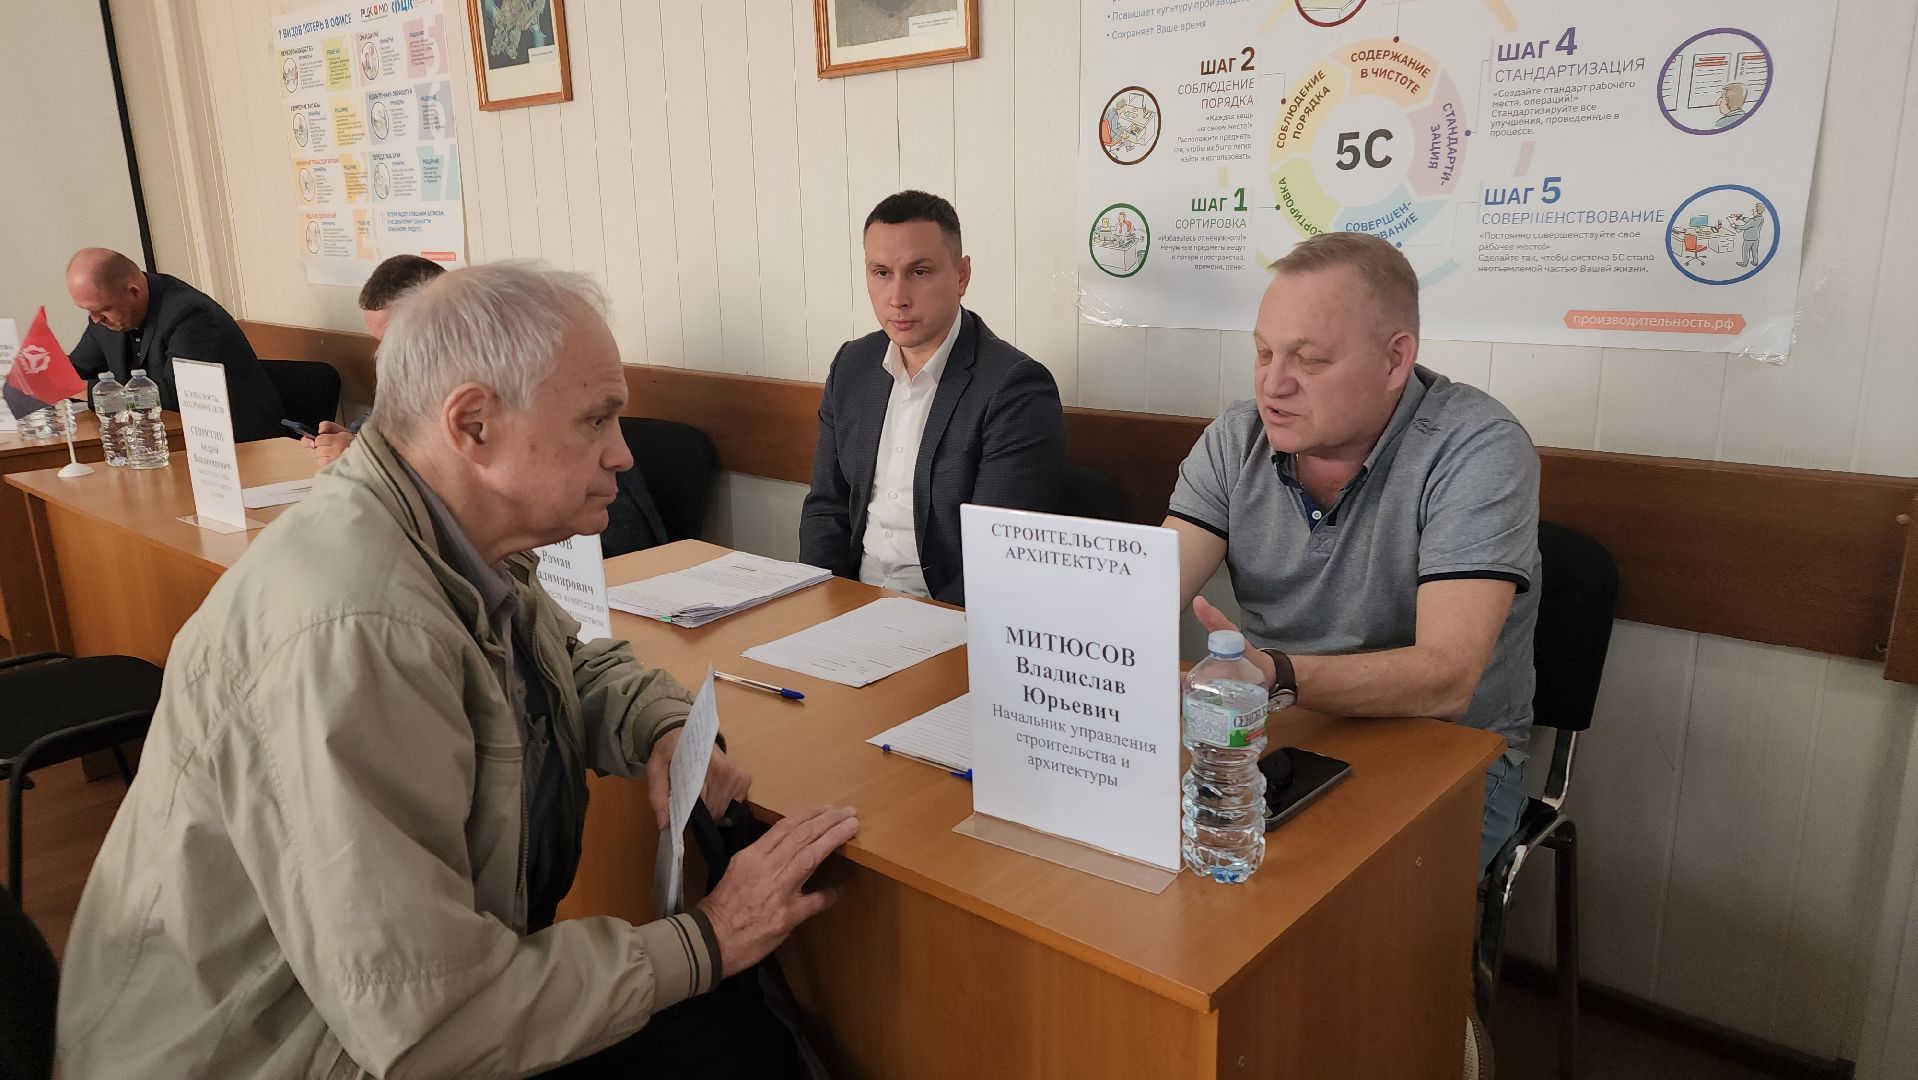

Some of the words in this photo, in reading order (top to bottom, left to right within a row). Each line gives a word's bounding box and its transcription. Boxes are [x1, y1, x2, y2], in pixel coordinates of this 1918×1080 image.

[1112, 7, 1154, 21] Повышает
[1156, 2, 1193, 16] культуру
[282, 25, 303, 39] ВИДОВ
[302, 20, 324, 34] ПОТЕРЬ
[325, 19, 330, 29] В
[329, 13, 352, 28] ОФИСЕ
[1111, 27, 1154, 40] Сохраняет
[1156, 23, 1179, 34] Ваше
[1180, 20, 1207, 32] время
[1497, 39, 1550, 61] ШАГ
[1555, 26, 1578, 55] 4
[1200, 57, 1237, 75] ШАГ
[1241, 46, 1255, 71] 2
[1350, 49, 1432, 79] СОДЕРЖАНИЕ
[1495, 57, 1646, 83] СТАНДАРТИЗАЦИЯ
[1177, 78, 1256, 95] СОБЛЮДЕНИЕ
[1360, 68, 1369, 79] В
[1371, 67, 1421, 95] ЧИСТОТЕ
[1493, 87, 1542, 98] «Создайте
[1543, 84, 1588, 96] стандарт
[1589, 80, 1636, 93] рабочего
[1201, 95, 1254, 110] ПОРЯДКА
[1276, 69, 1326, 149] СОБЛЮДЕНИЕ
[1292, 85, 1331, 140] ПОРЯДКА
[1491, 104, 1579, 118] Стандартизируйте
[1580, 104, 1597, 112] все
[1524, 95, 1579, 107] операций!»
[1490, 118, 1544, 130] улучшения,
[1545, 113, 1612, 125] проведенные
[1335, 128, 1394, 171] 5С
[1427, 124, 1441, 170] ЗАЦИЯ
[1440, 102, 1459, 186] СТАНДАРТИ-
[1191, 197, 1227, 212] ШАГ
[1233, 187, 1248, 212] 1
[1484, 187, 1535, 206] ШАГ
[1540, 176, 1562, 204] 5
[1175, 217, 1247, 229] СОРТИРОВКА
[1345, 201, 1412, 232] СОВЕРШЕН-
[1481, 209, 1665, 225] СОВЕРШЕНСТВОВАНИЕ
[1478, 243, 1514, 252] рабочее
[1479, 231, 1532, 240] «Постоянно
[1533, 230, 1616, 241] совершенствуйте
[1478, 253, 1520, 262] Сделайте
[1540, 253, 1568, 262] чтобы
[1570, 254, 1610, 262] система
[1612, 253, 1626, 261] 5С
[1478, 264, 1543, 273] неотъемлемой
[1544, 264, 1578, 273] частью
[1580, 264, 1612, 273] Вашей
[1613, 265, 1649, 273] жизни.
[1572, 314, 1735, 330] производительность.рф
[991, 523, 1147, 558] СТРОИТЕЛЬСТВО,
[541, 549, 572, 570] Роман
[1005, 546, 1132, 576] АРХИТЕКТУРА
[537, 570, 594, 596] адимирович
[1006, 625, 1136, 667] МИТЮСОВ
[1016, 656, 1126, 695] Владислав
[1023, 684, 1121, 723] Юрьевич
[993, 704, 1066, 733] Начальник
[1070, 724, 1157, 754] управления
[1016, 732, 1116, 765] строительства
[1121, 757, 1130, 769] и
[1027, 755, 1118, 787] архитектуры
